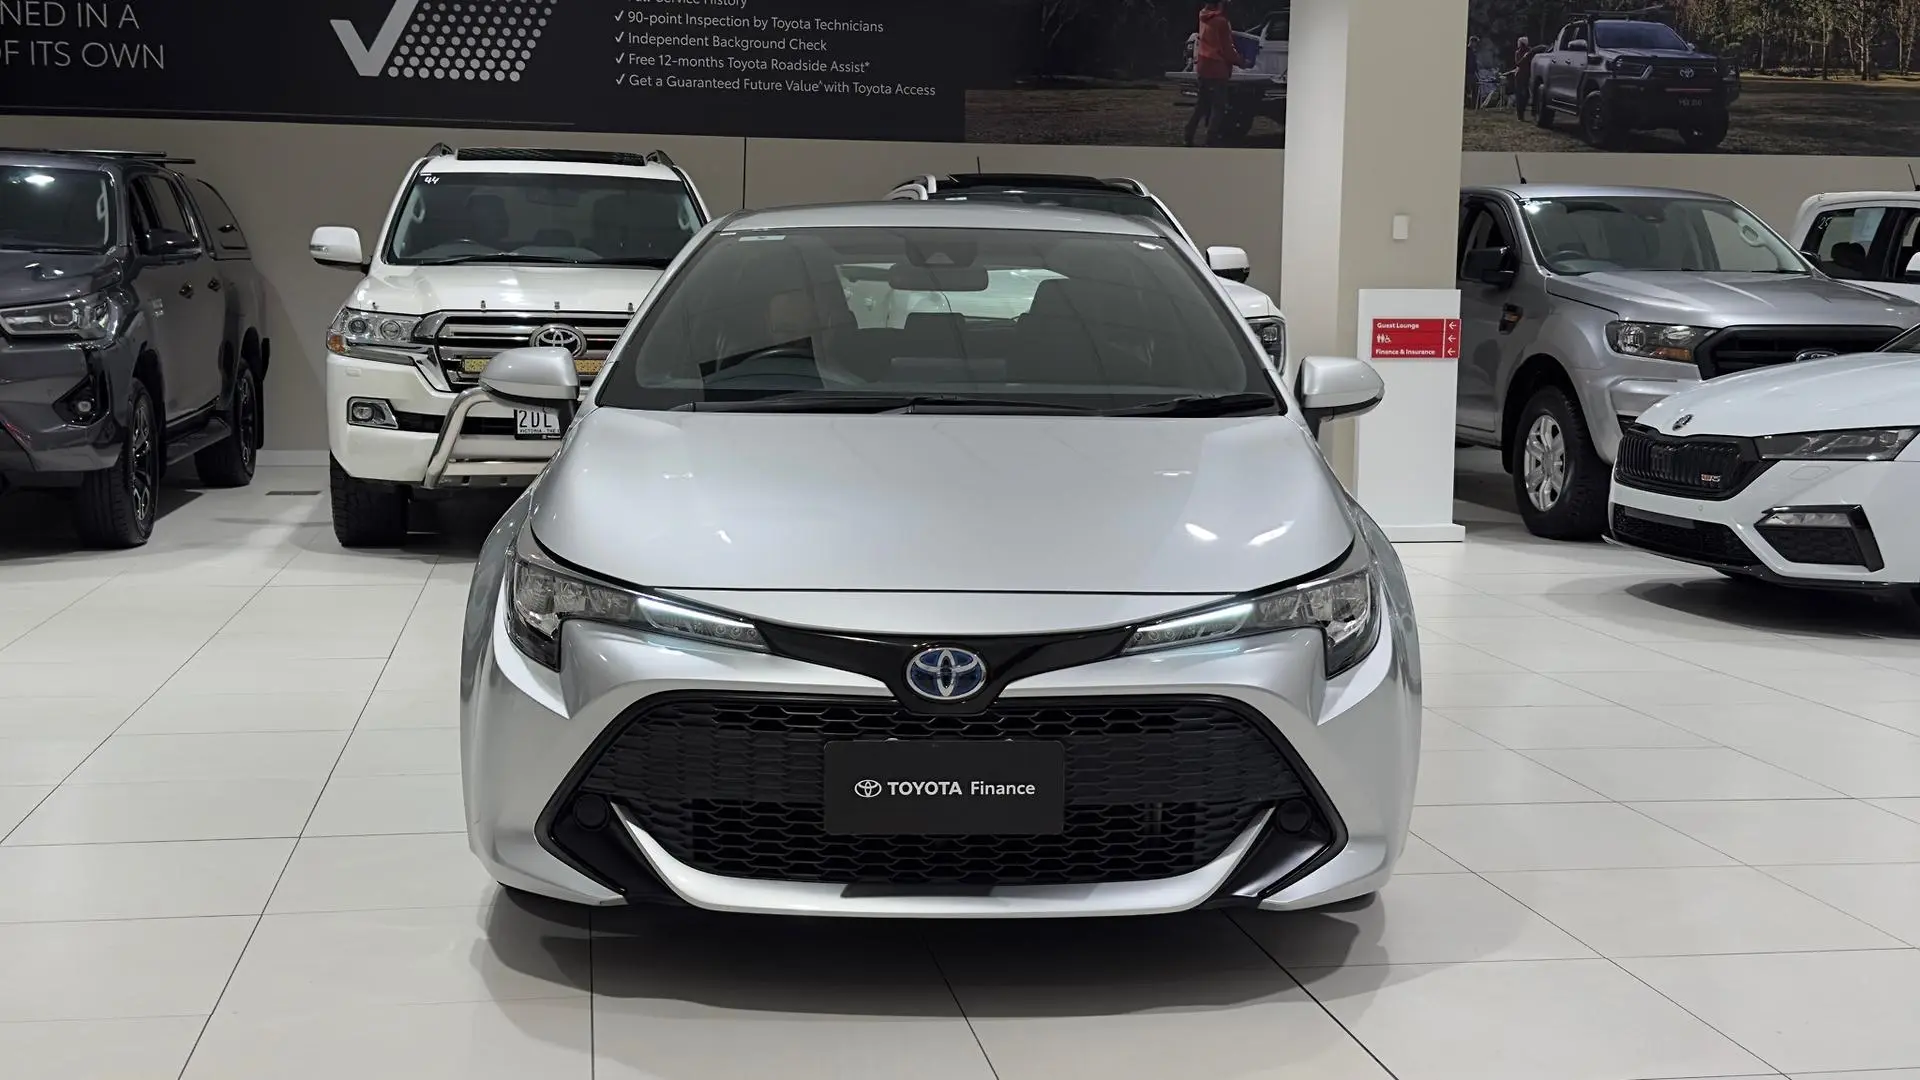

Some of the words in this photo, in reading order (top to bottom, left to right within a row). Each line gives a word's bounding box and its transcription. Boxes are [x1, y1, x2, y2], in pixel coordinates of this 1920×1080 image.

[0, 0, 66, 27] NED
[77, 2, 108, 29] IN
[118, 3, 141, 30] A
[628, 11, 682, 27] 90-point
[685, 14, 750, 29] Inspection
[753, 16, 769, 31] by
[771, 17, 811, 32] Toyota
[814, 18, 884, 32] Technicians
[628, 32, 709, 48] Independent
[712, 36, 786, 51] Background
[788, 38, 827, 51] Check
[0, 40, 20, 66] F
[30, 40, 71, 67] ITS
[81, 41, 165, 70] OWN
[628, 53, 656, 66] Free
[658, 55, 724, 69] 12-months
[727, 56, 768, 71] Toyota
[771, 59, 827, 72] Roadside
[628, 75, 653, 87] Get
[655, 78, 663, 87] a
[666, 76, 740, 90] Guaranteed
[743, 78, 783, 91] Future
[824, 81, 850, 93] with
[852, 82, 892, 97] Toyota
[895, 83, 936, 96] Access
[887, 781, 963, 796] TOYOTA
[970, 780, 1036, 795] Finance
